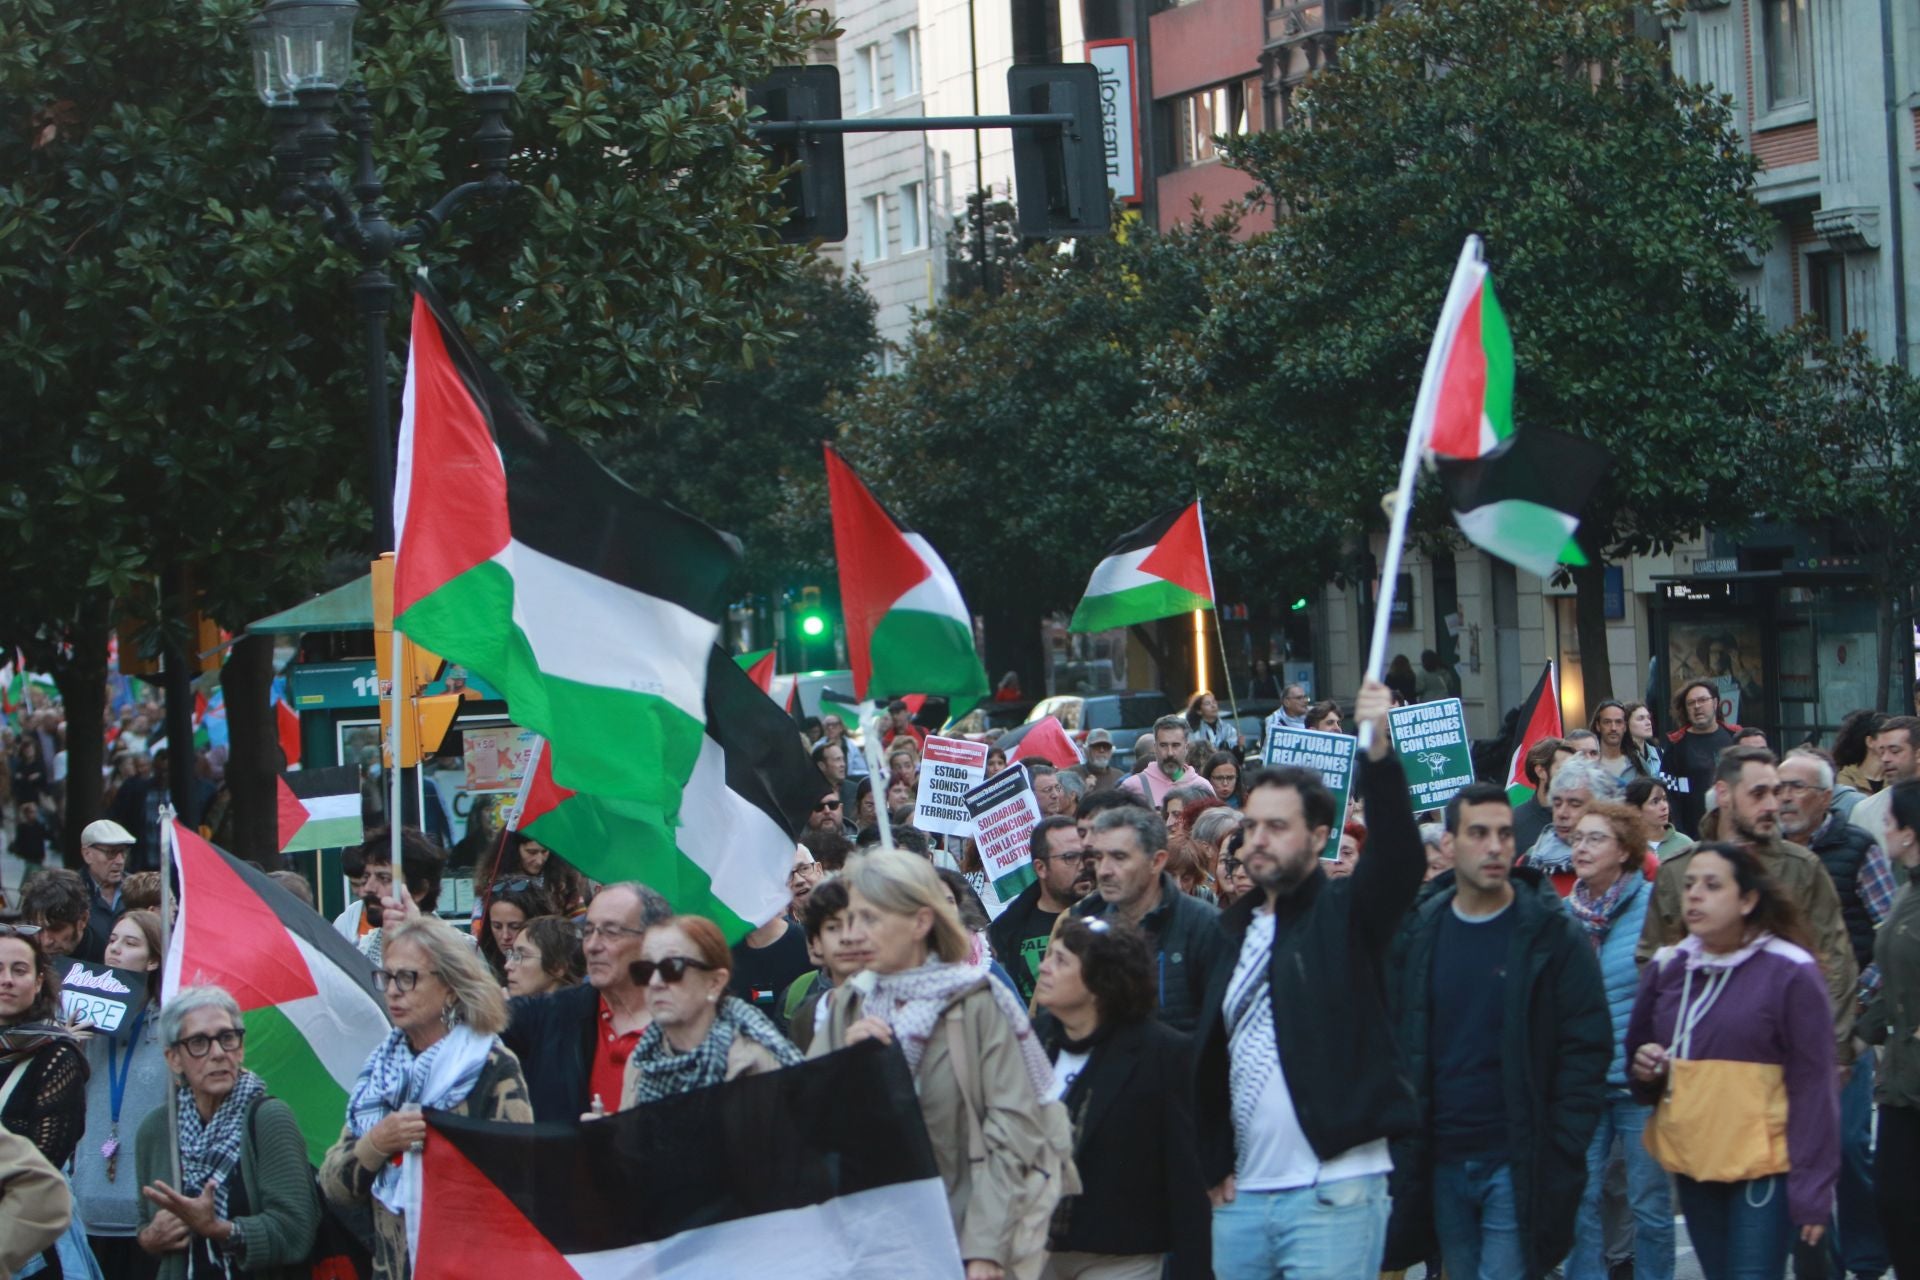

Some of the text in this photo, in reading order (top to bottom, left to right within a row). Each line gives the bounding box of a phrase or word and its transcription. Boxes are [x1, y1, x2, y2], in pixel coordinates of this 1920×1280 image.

[1392, 702, 1458, 727] RUPTURA DE
[1395, 716, 1461, 740] RELACIONES
[1273, 731, 1351, 754] RUPTURA DE
[1400, 733, 1462, 754] CON ISRAEL
[1271, 748, 1348, 773] RELACIONES
[934, 765, 968, 780] ESTADO
[1428, 775, 1471, 792] COMERCIO
[1420, 793, 1432, 804] DE
[977, 798, 1026, 831] SOLIDARIDAD
[978, 809, 1035, 847] INTERNACIONAL
[985, 841, 1003, 859] CON
[1001, 837, 1011, 850] LA
[996, 842, 1031, 869] PALESTIN
